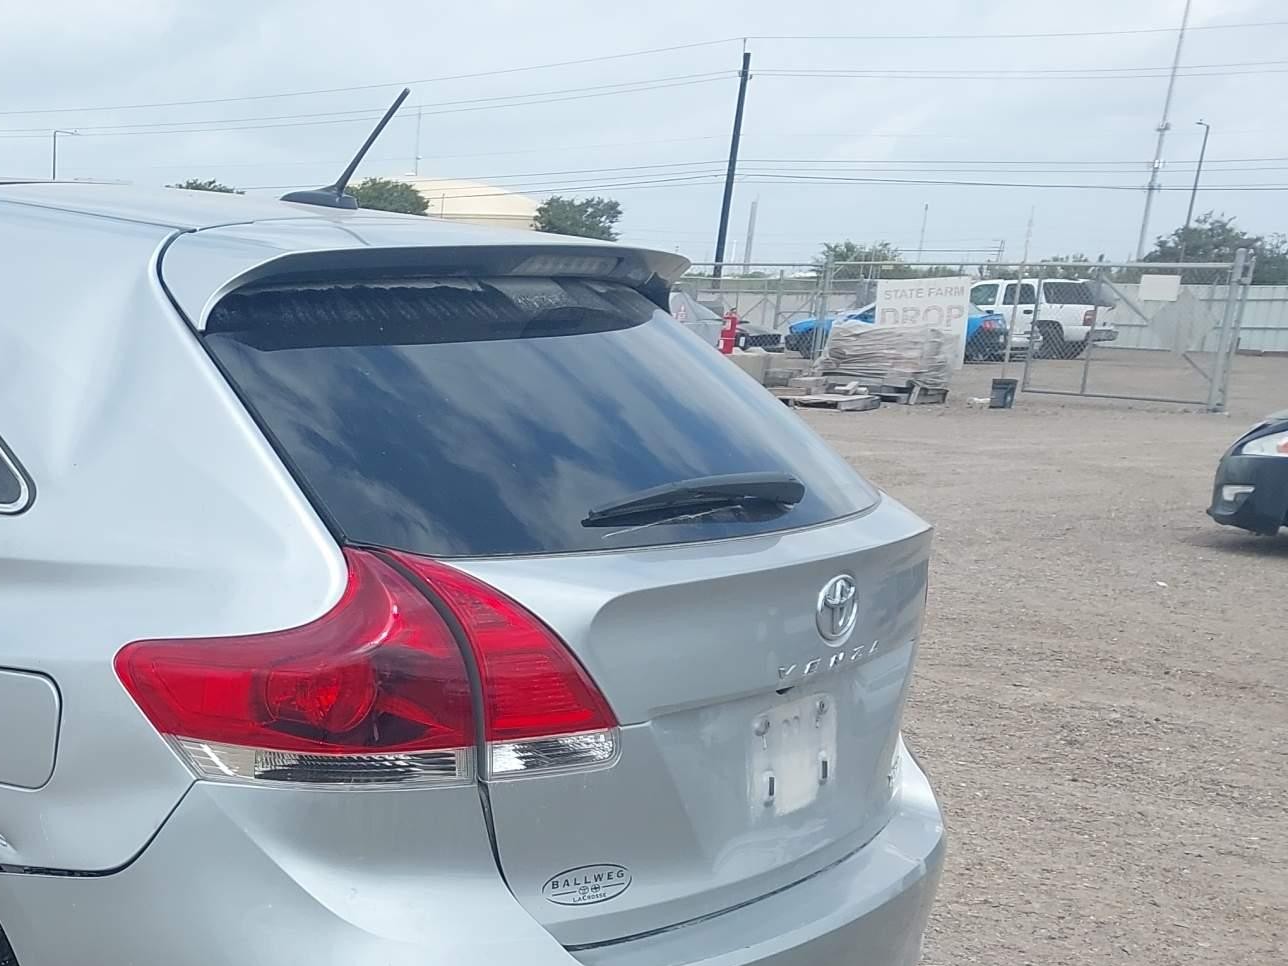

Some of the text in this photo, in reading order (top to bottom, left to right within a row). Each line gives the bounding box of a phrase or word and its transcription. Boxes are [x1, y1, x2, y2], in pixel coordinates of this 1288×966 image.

[884, 286, 965, 300] STATE FARM
[880, 304, 965, 328] DROP
[551, 869, 625, 890] BALLWEG
[572, 892, 607, 903] LACROSSE
